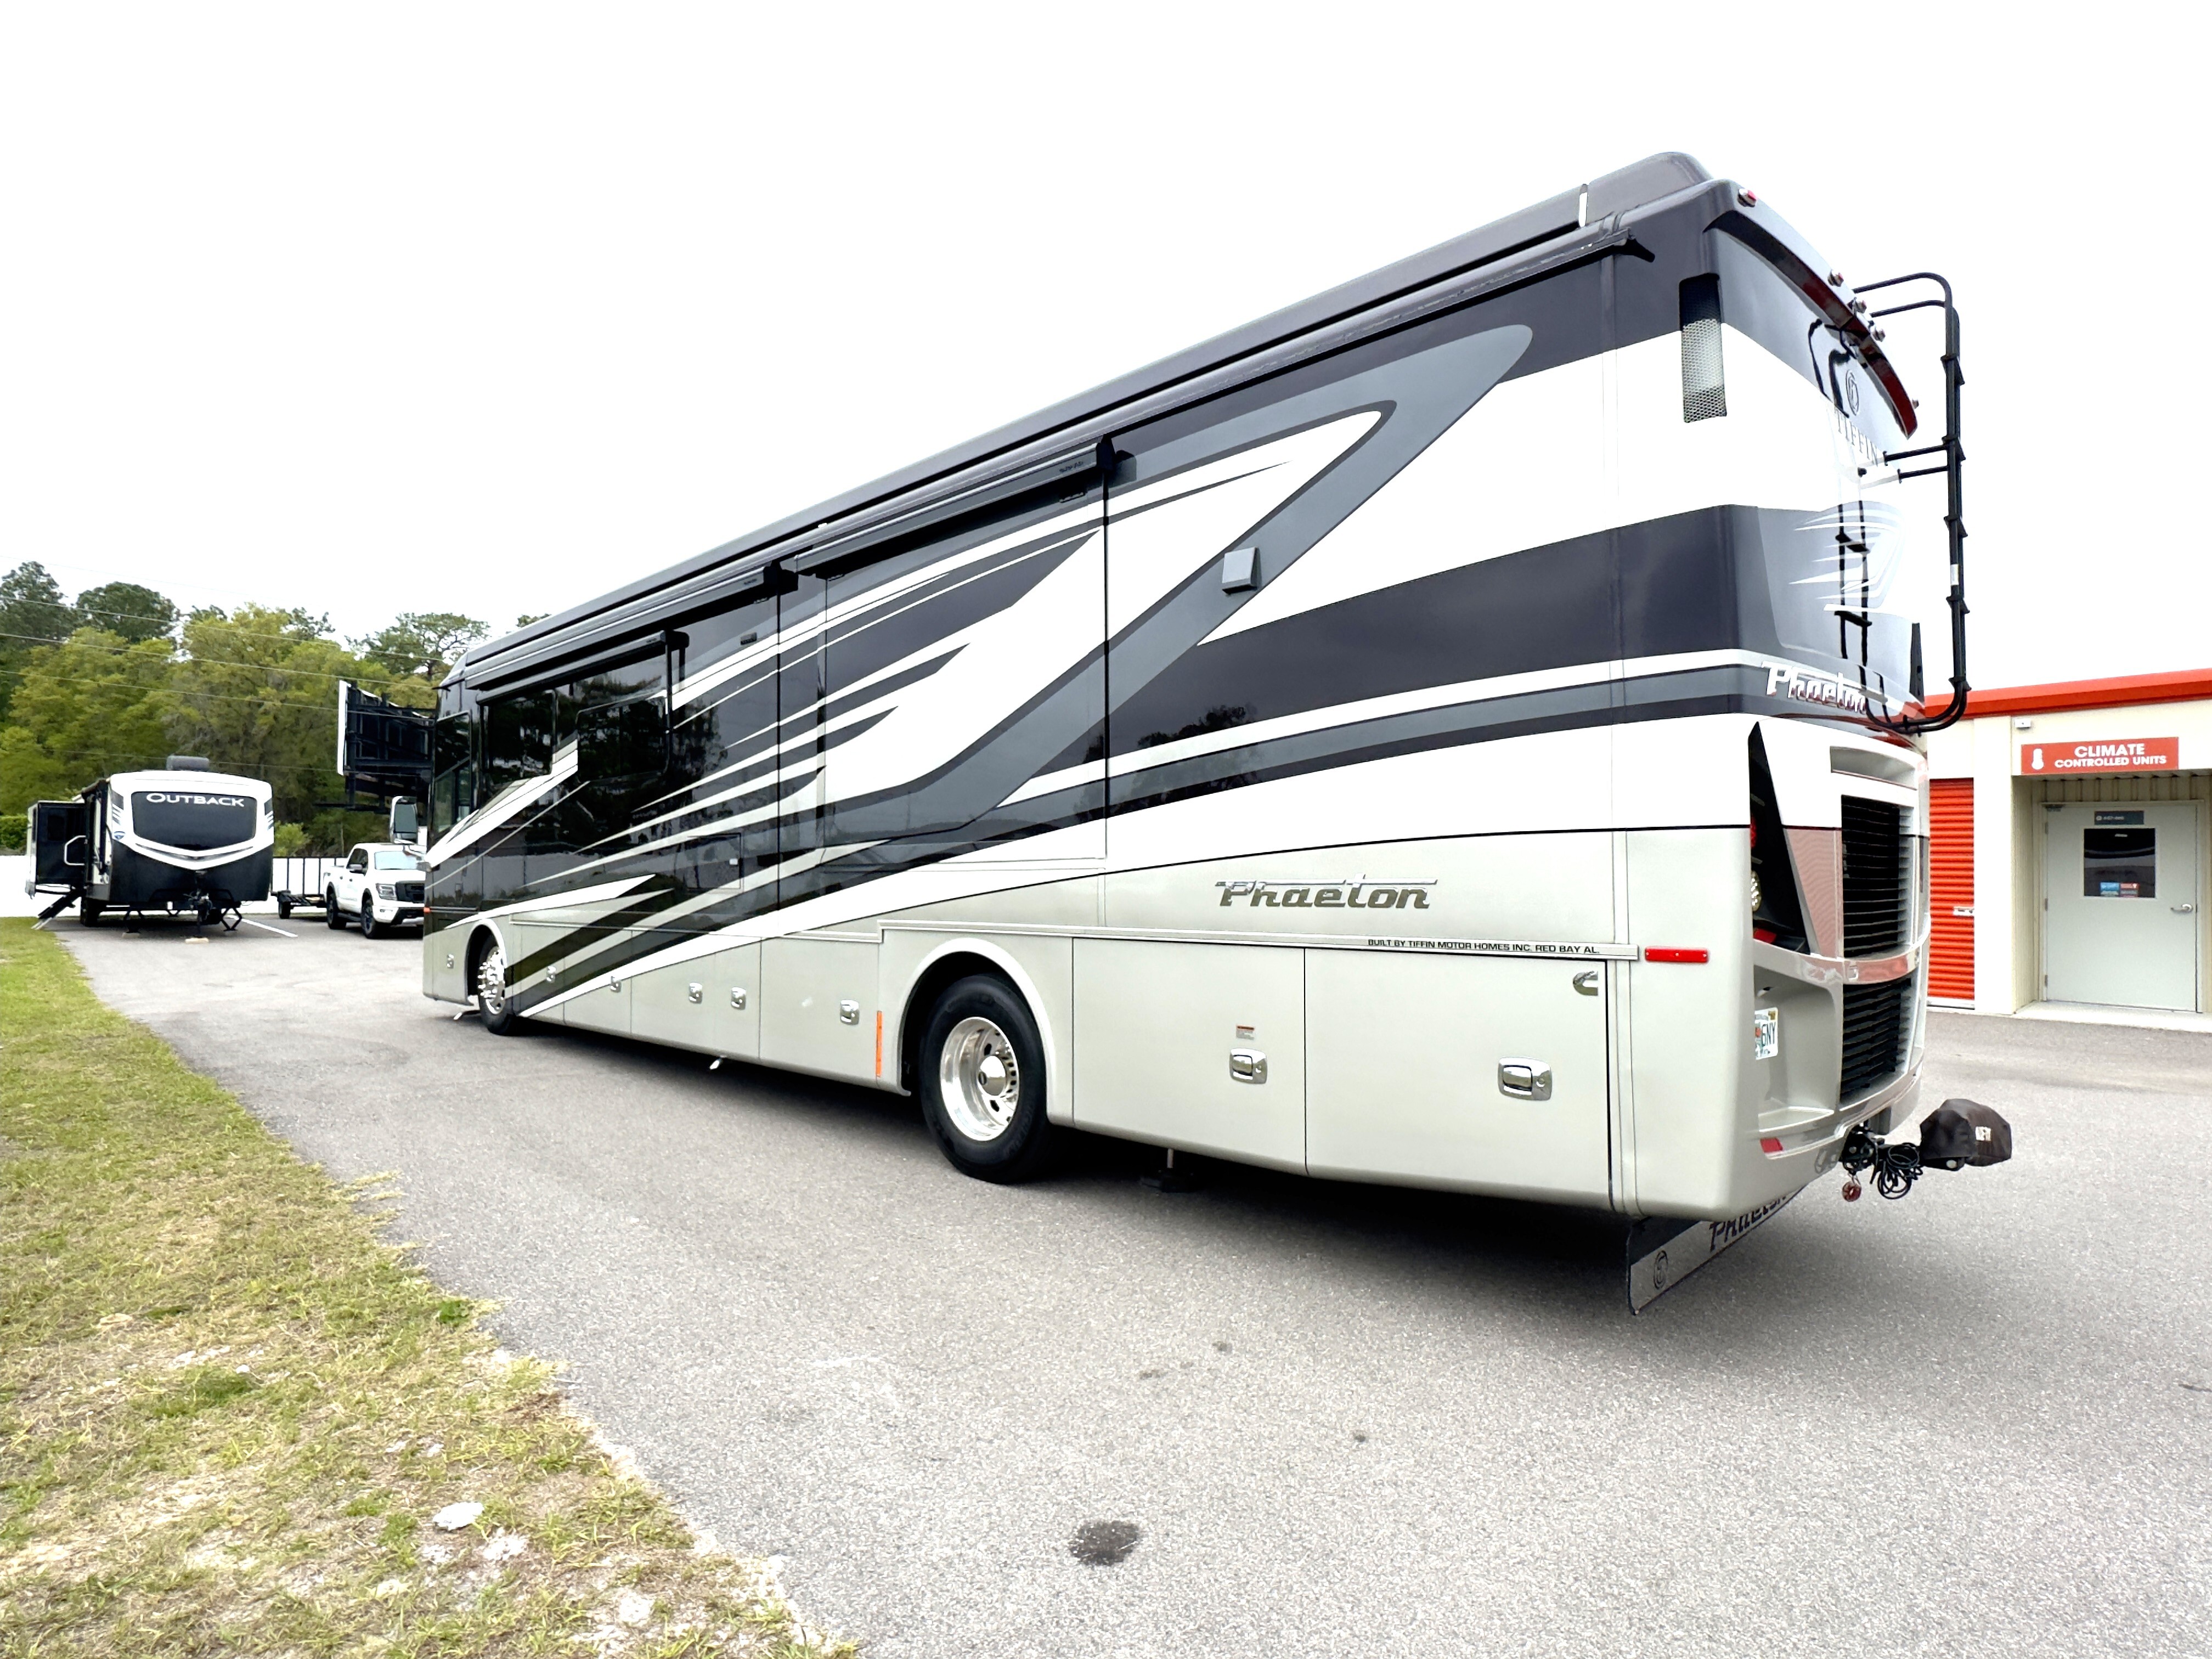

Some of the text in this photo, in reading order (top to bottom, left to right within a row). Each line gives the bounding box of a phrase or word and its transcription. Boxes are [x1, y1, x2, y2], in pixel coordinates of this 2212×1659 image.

[1835, 408, 1878, 467] TIFFIN
[2074, 743, 2145, 758] CLIMATE
[2054, 755, 2166, 768] CONTROLLED UNITS
[146, 793, 245, 807] OUTBACK
[1215, 873, 1438, 909] Phaeton
[1474, 943, 1509, 951] HOMES
[1583, 946, 1600, 954] AL.
